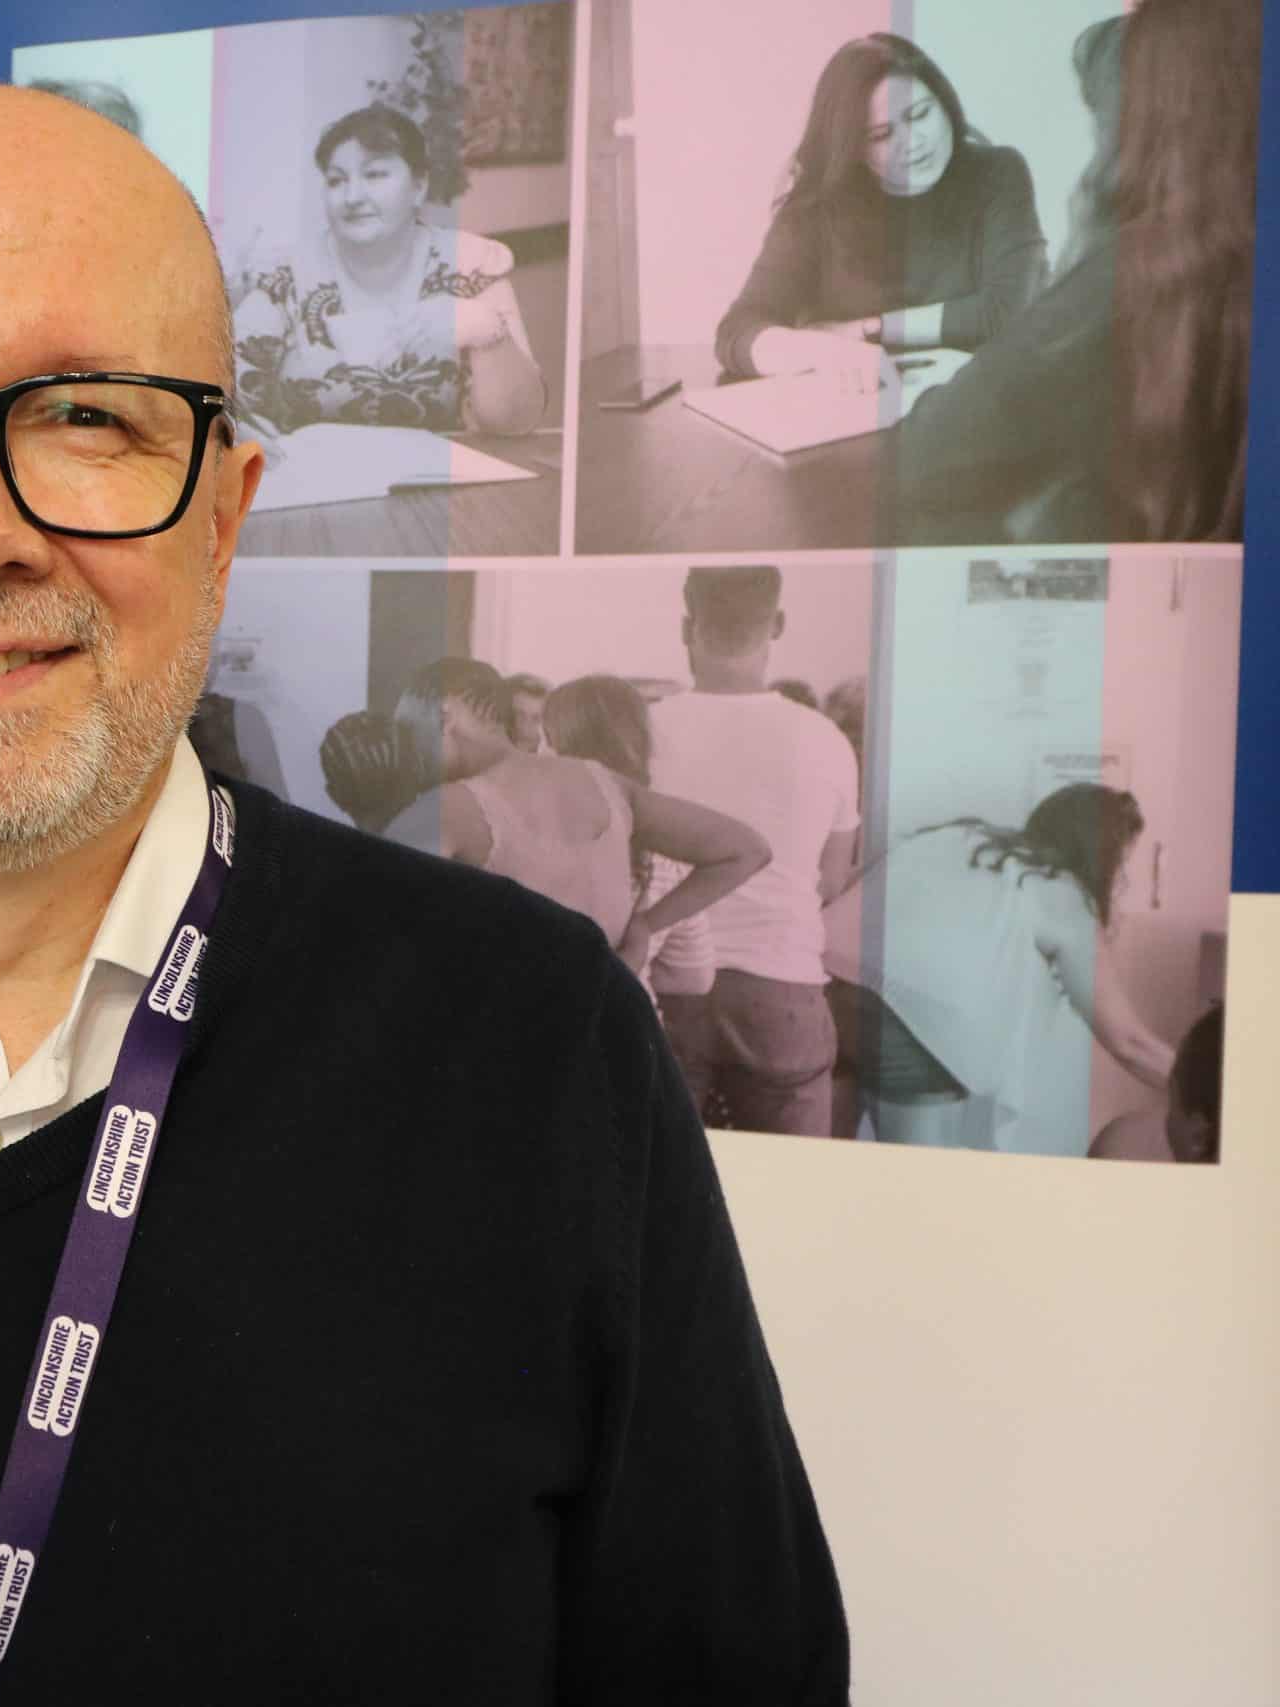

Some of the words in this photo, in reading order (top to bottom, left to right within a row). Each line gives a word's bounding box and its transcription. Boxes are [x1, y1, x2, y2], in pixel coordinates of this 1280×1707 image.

[152, 930, 196, 1006] LINCOLNSHIRE
[91, 1112, 128, 1203] LINCOLNSHIRE
[115, 1161, 140, 1209] ACTION
[128, 1118, 151, 1158] TRUST
[32, 1322, 70, 1420] LINCOLNSHIRE
[56, 1377, 81, 1428] ACTION
[70, 1331, 94, 1373] TRUST
[7, 1558, 30, 1602] TRUST
